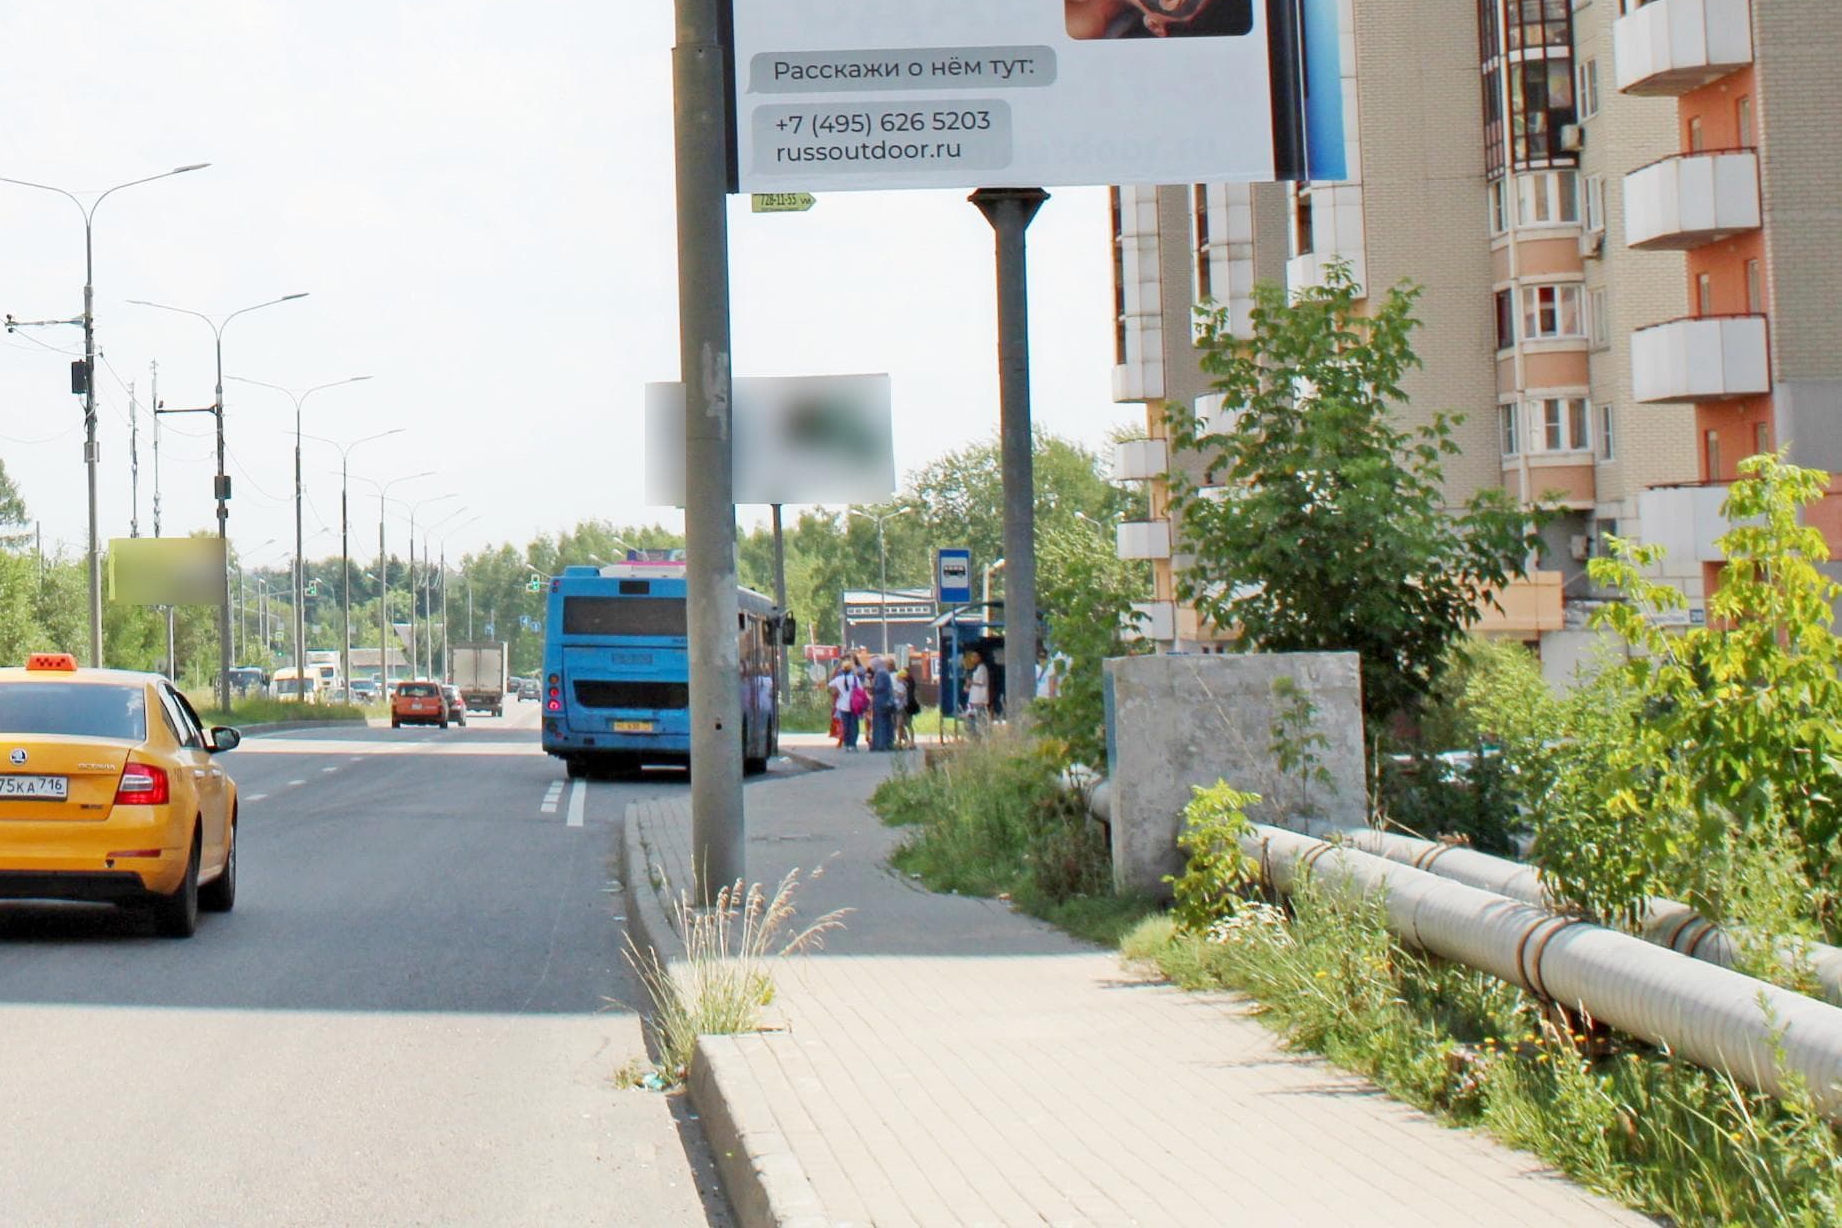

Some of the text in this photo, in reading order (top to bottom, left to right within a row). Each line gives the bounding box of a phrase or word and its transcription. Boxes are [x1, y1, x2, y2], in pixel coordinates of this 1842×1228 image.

[774, 56, 1035, 80] Расскажи о нём тут:
[775, 111, 991, 138] +7 (495) 626 5203
[776, 140, 961, 162] russoutdoor.ru
